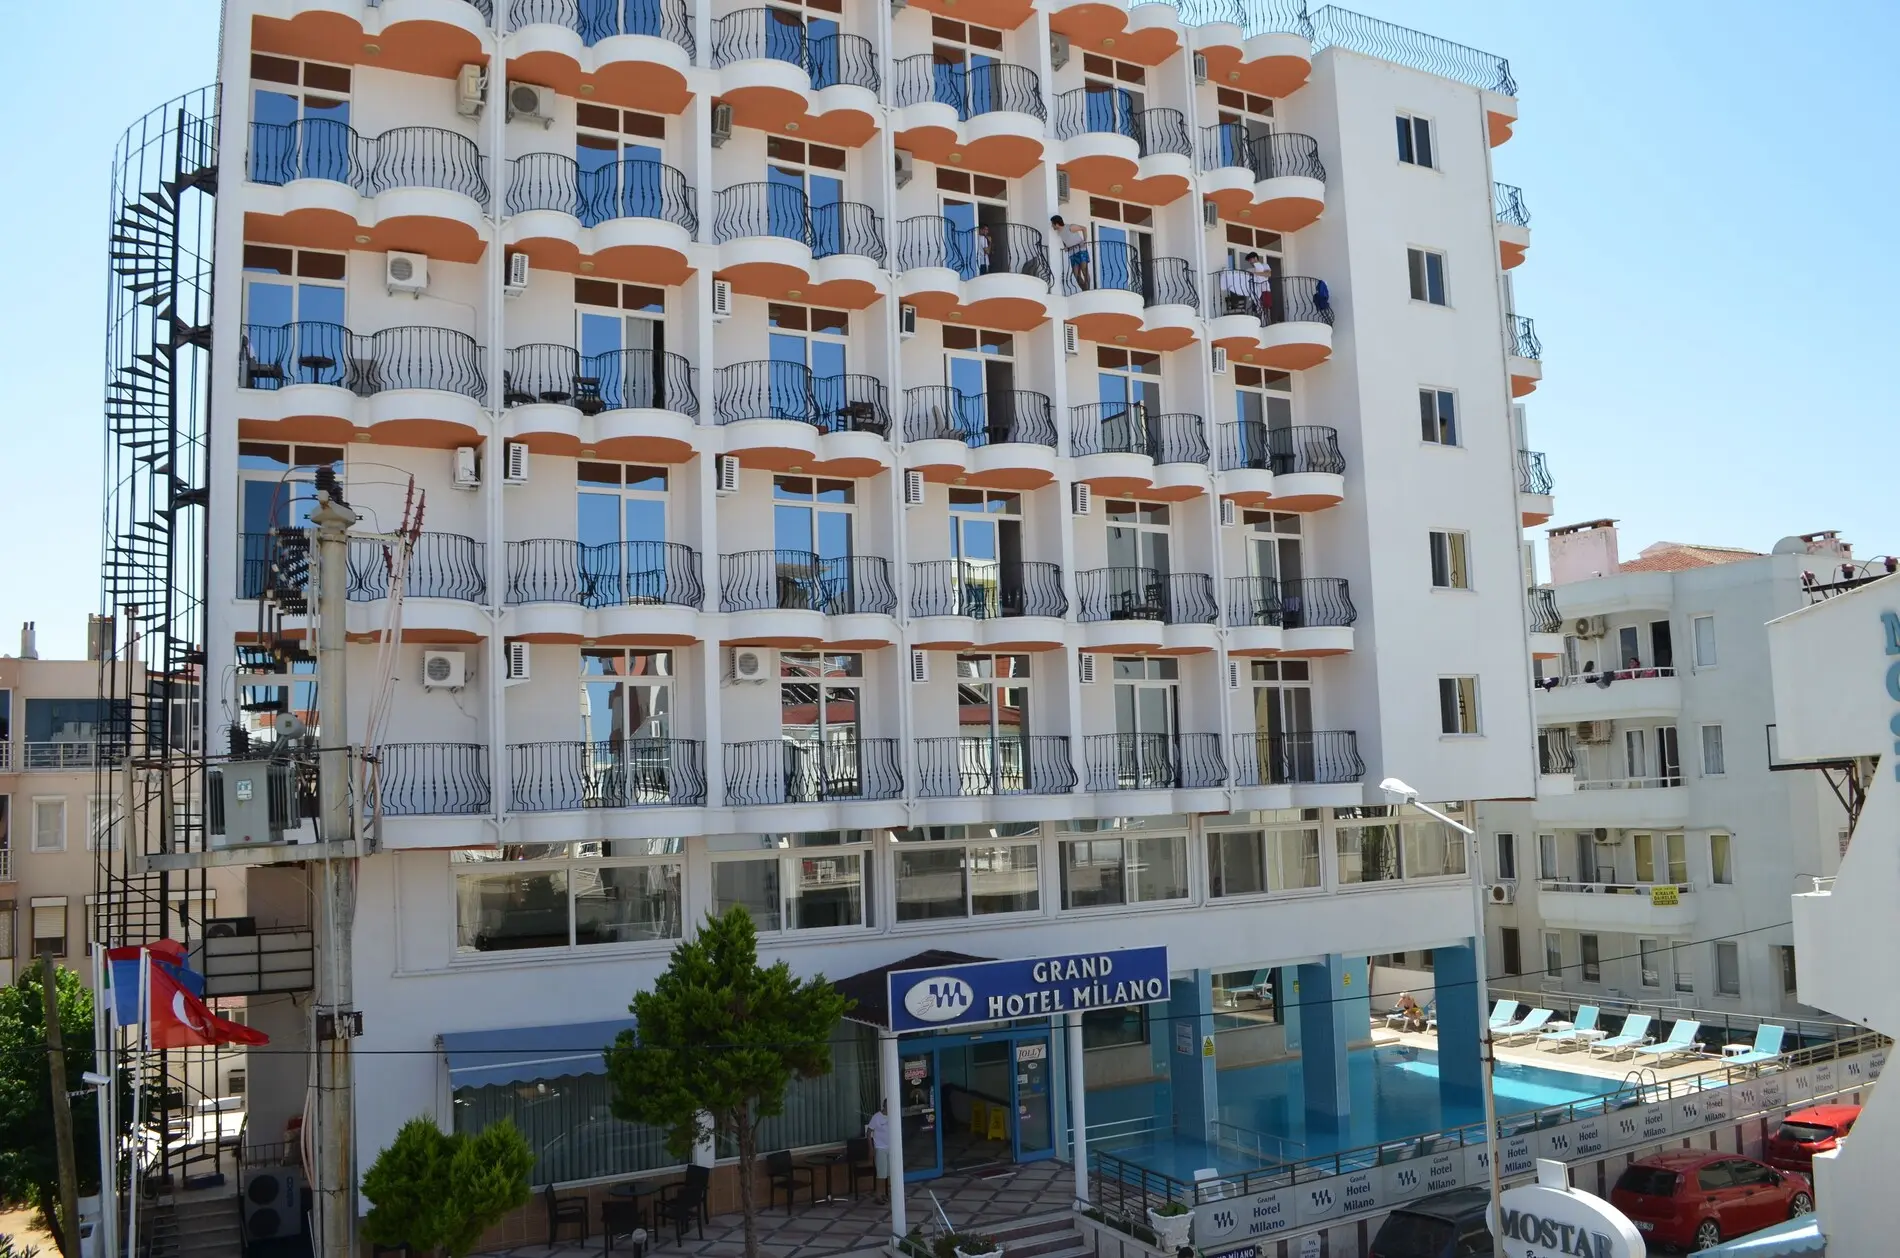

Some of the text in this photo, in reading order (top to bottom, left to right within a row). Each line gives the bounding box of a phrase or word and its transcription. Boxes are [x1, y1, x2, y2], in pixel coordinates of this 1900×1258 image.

[1032, 956, 1113, 983] GRAND
[988, 989, 1064, 1018] HOTEL
[1645, 1113, 1663, 1125] Hotel
[1579, 1129, 1598, 1141] Hotel
[1643, 1127, 1666, 1138] Milano
[1507, 1146, 1528, 1158] Hotel
[1576, 1143, 1602, 1155] Milano
[1430, 1163, 1452, 1176] Hotel
[1504, 1160, 1532, 1173] Milano
[1349, 1174, 1366, 1183] Grand
[1346, 1182, 1371, 1196] Hotel
[1427, 1179, 1456, 1192] Milano
[1257, 1194, 1276, 1204] Grand
[1343, 1197, 1375, 1212] Milano
[1253, 1203, 1281, 1217] Hotel
[1249, 1218, 1285, 1234] Milano
[1500, 1206, 1613, 1258] MOSTAR
